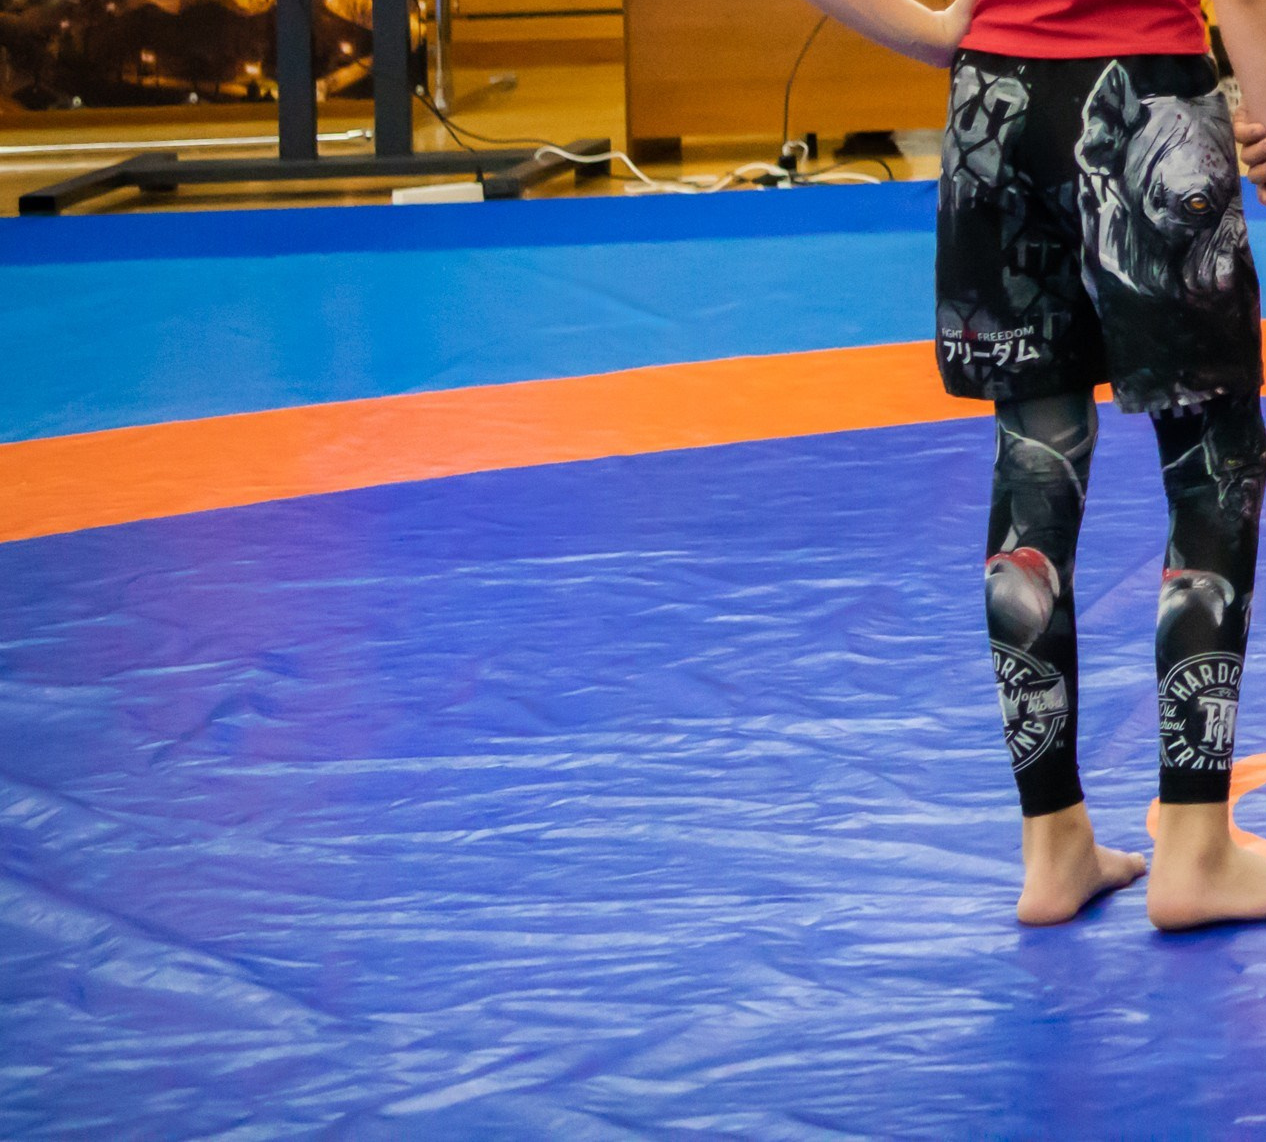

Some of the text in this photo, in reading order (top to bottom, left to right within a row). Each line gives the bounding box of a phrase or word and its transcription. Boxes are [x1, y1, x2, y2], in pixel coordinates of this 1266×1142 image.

[977, 325, 1035, 342] FREEDOM
[943, 339, 1040, 367] フリーダム
